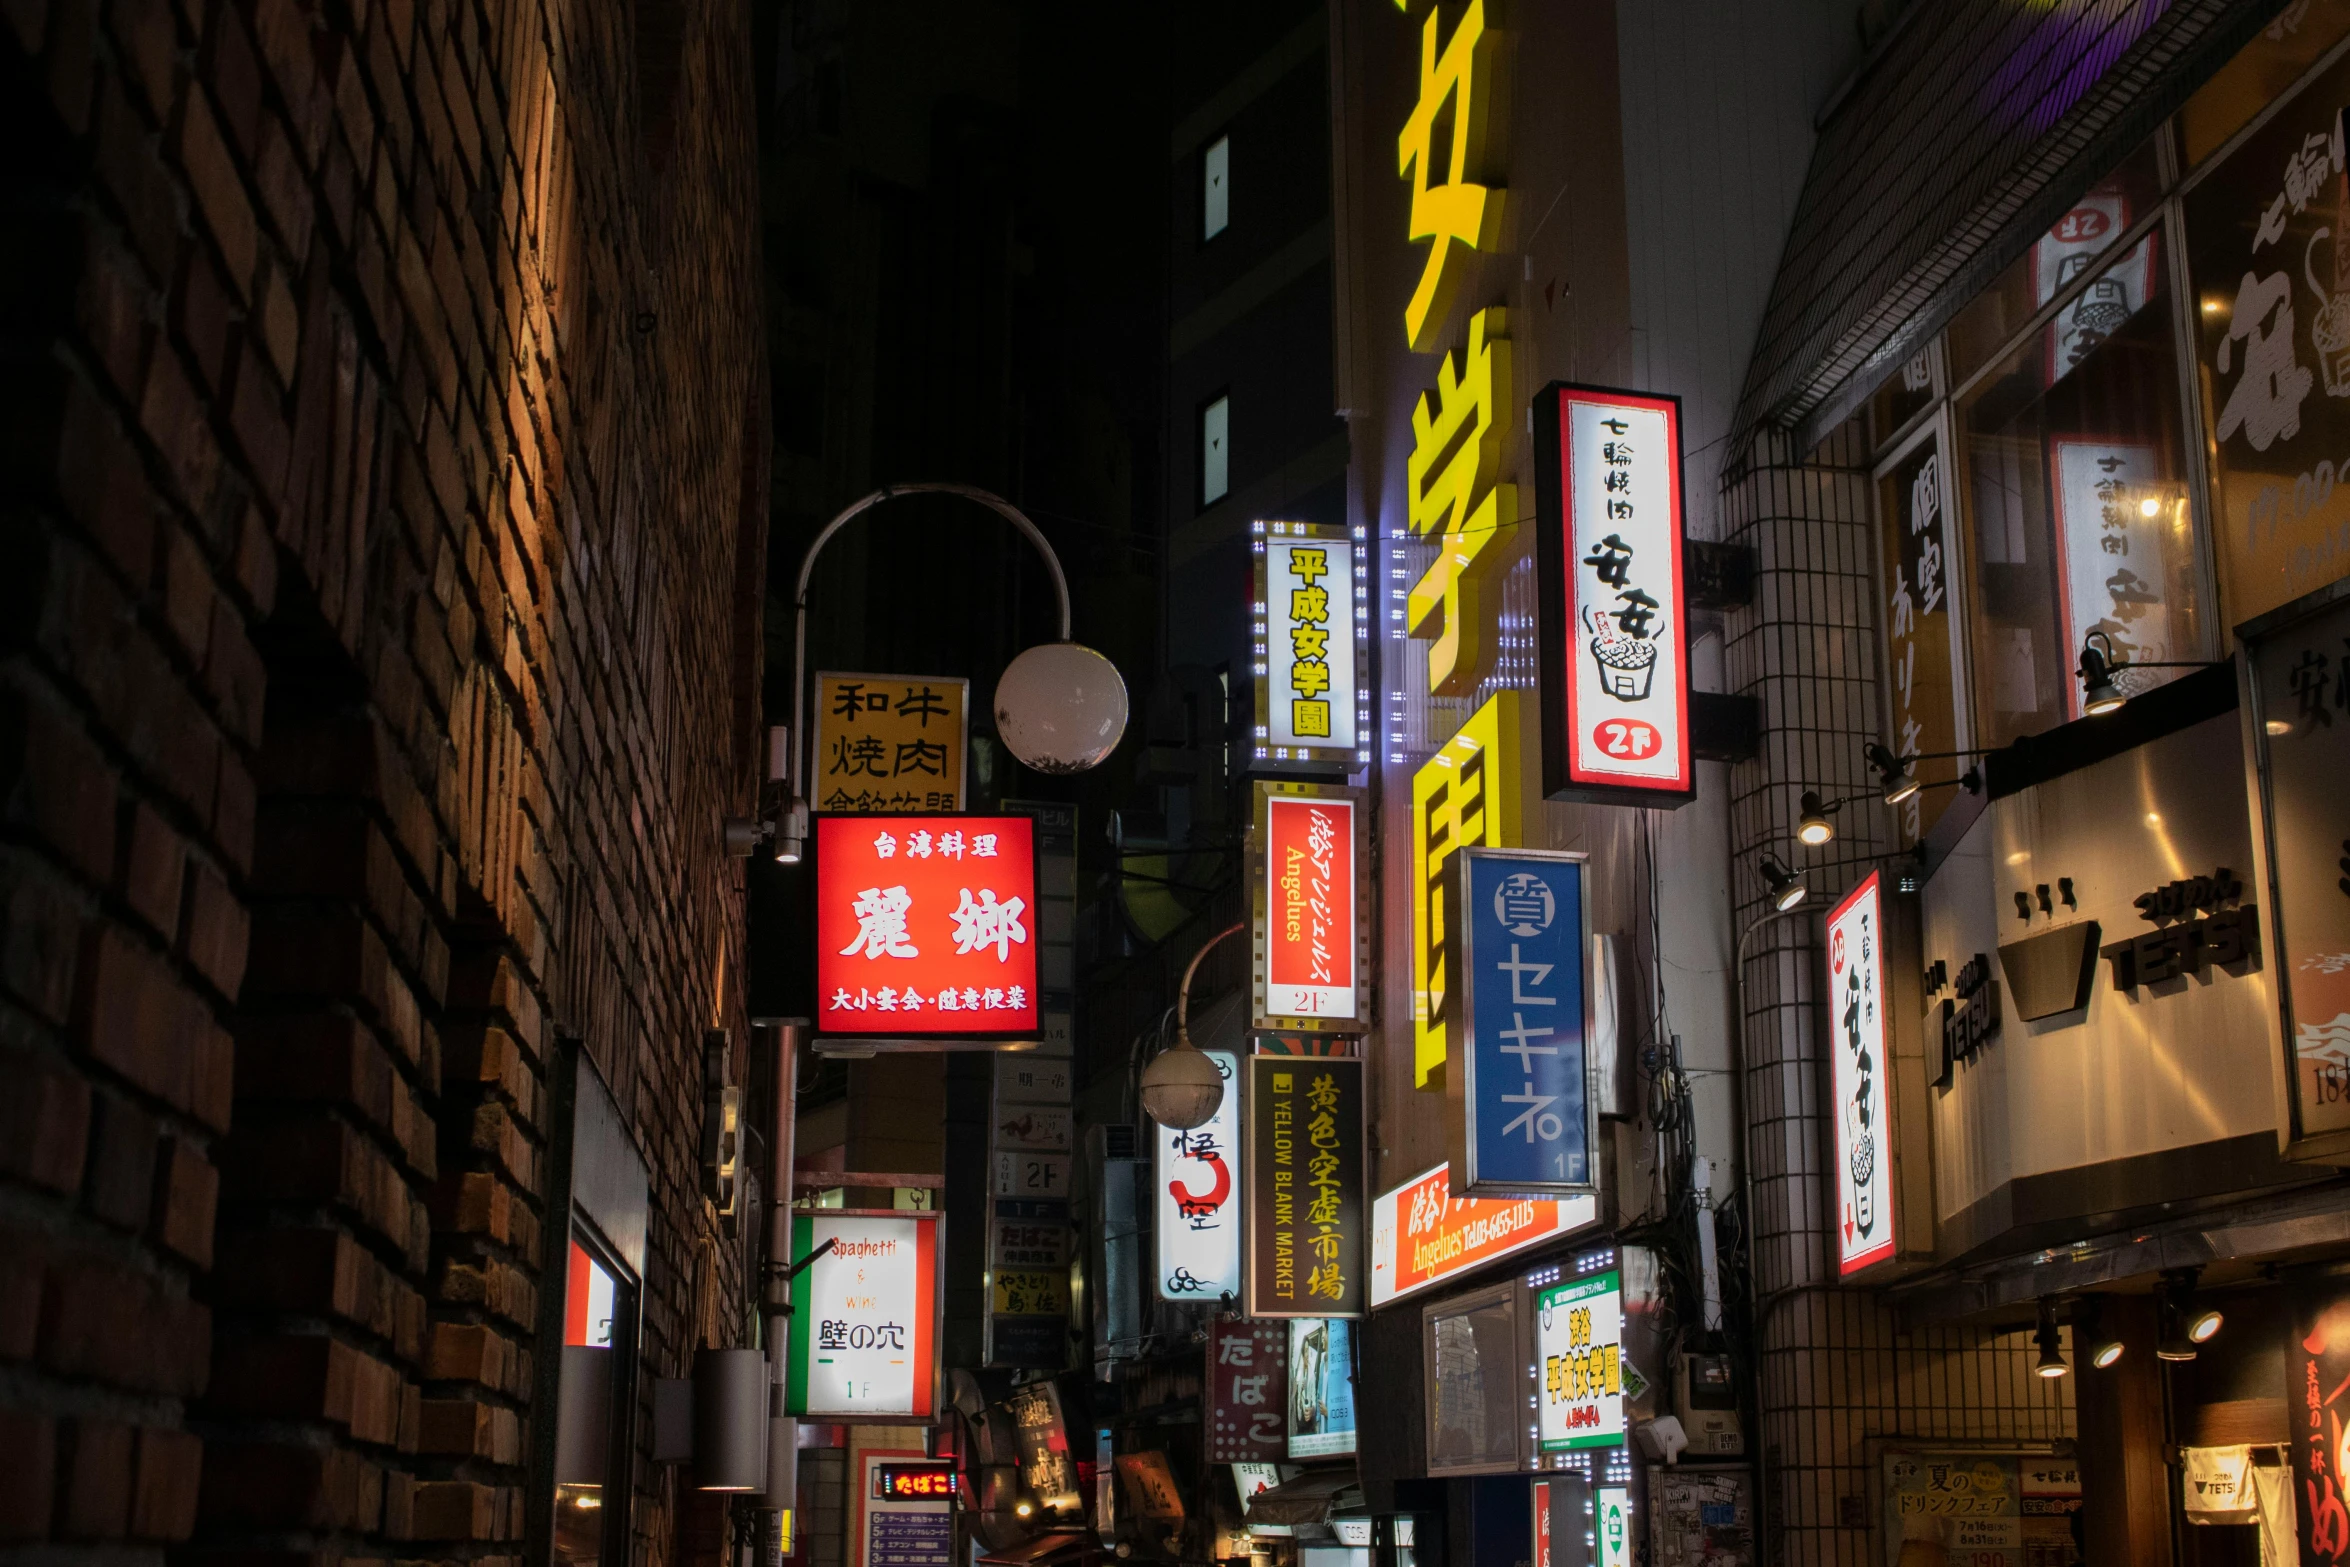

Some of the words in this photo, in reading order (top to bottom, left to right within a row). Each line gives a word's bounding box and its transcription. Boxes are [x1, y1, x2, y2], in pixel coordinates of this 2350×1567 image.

[1600, 417, 1634, 520] 七輪焼肉
[1396, 0, 1501, 1090] 女学園
[1583, 533, 1661, 642] 安安
[1289, 547, 1331, 738] 平成女学園
[832, 683, 950, 728] 和牛
[829, 734, 948, 779] 焼肉
[1606, 724, 1651, 757] 2F
[872, 829, 999, 861] 台湾料理
[1280, 845, 1307, 942] Angelues
[1496, 875, 1554, 934] 質
[839, 885, 1027, 963] 麗郷
[1294, 991, 1329, 1013] 2F
[1944, 979, 1998, 1063] TETSU
[1497, 943, 1563, 1144] セキネ
[1843, 963, 1873, 1134] 安安
[1274, 1101, 1293, 1166] YELLOW
[1027, 1161, 1058, 1189] 2F
[1172, 1129, 1225, 1231] 悟空
[1554, 1153, 1582, 1178] 1F
[1275, 1172, 1293, 1226] BLANK
[831, 1237, 898, 1260] Spaghetti
[1000, 1226, 1061, 1248] たばこ
[1412, 1224, 1463, 1279] Angelues
[998, 1274, 1050, 1292] やきとり
[1275, 1232, 1294, 1299] MARKET
[818, 1319, 905, 1351] 壁の穴
[1569, 1306, 1592, 1349] 渋谷
[1219, 1334, 1283, 1444] たばこ
[1546, 1342, 1621, 1405] 平成女学園
[895, 1473, 949, 1494] たばこ
[1927, 1463, 1970, 1492] 夏の
[872, 1512, 886, 1524] 6F
[1900, 1495, 2007, 1514] ドリンクフェア
[871, 1539, 885, 1550] 4F
[872, 1526, 886, 1537] 5F
[871, 1552, 885, 1564] 3F
